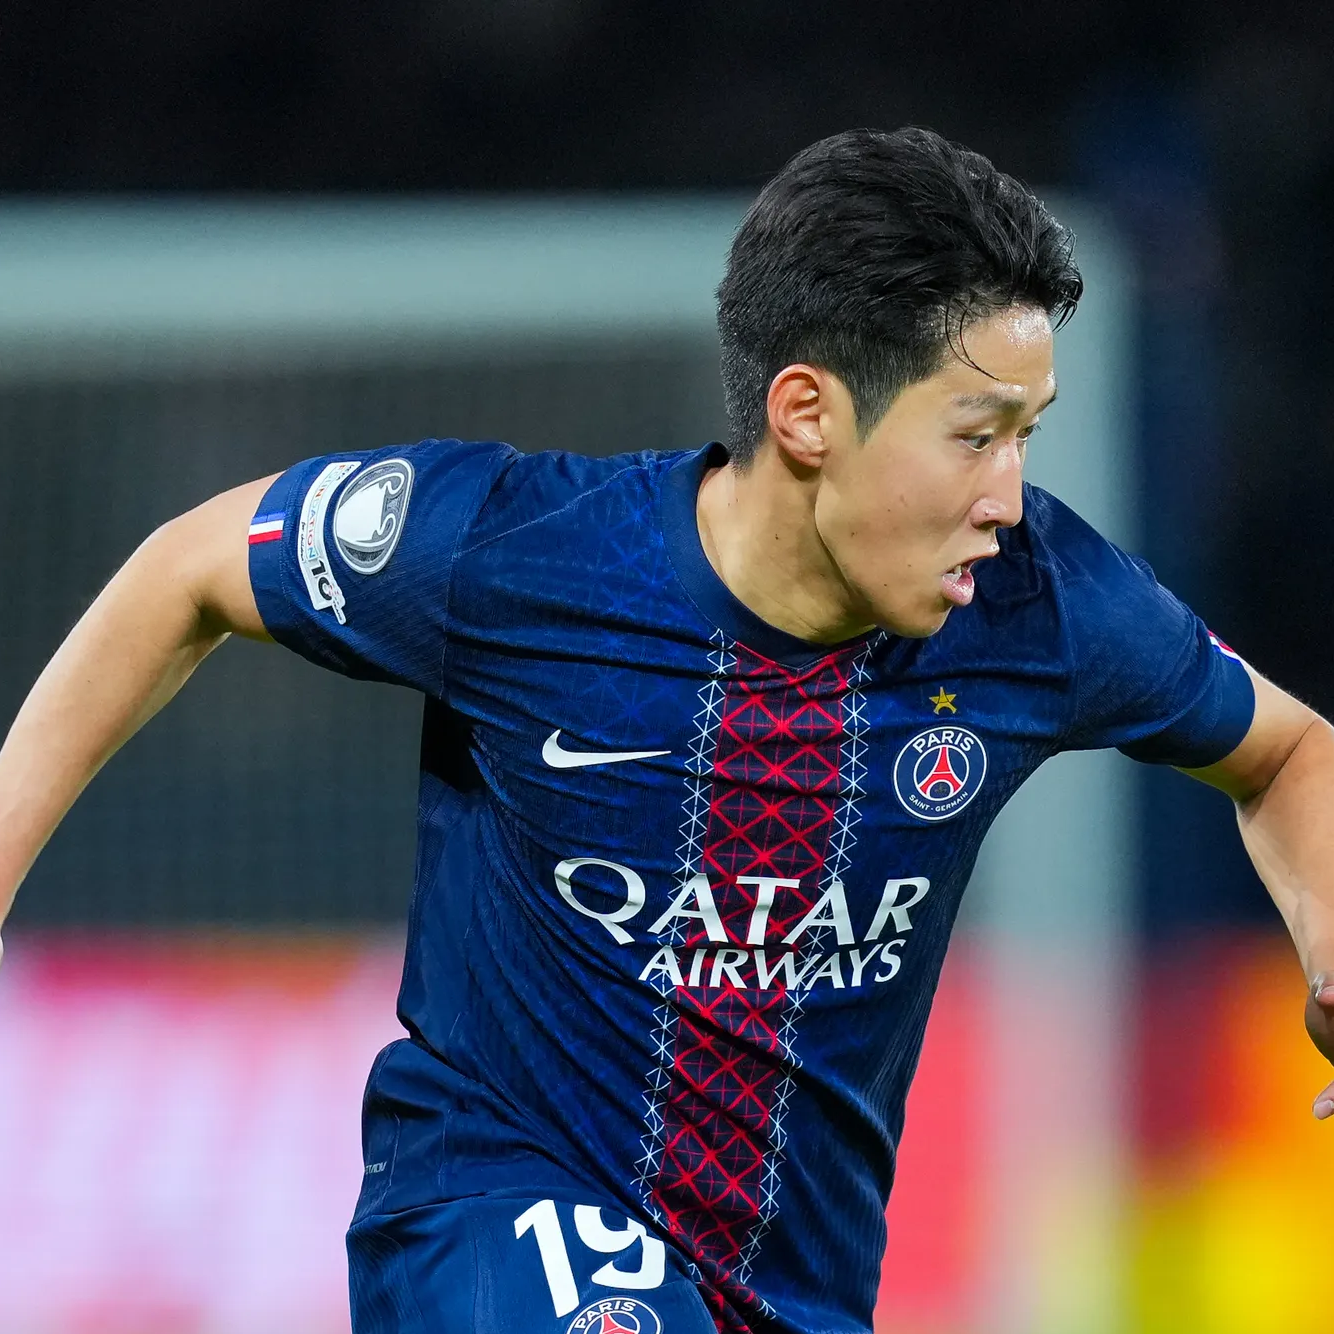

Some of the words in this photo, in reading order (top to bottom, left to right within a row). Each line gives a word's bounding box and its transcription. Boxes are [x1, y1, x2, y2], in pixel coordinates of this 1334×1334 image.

[912, 730, 974, 754] PARIS
[553, 857, 931, 945] QATAR
[638, 939, 907, 991] AIRWAYS
[514, 1198, 666, 1319] 19
[574, 1301, 637, 1329] PARIS
